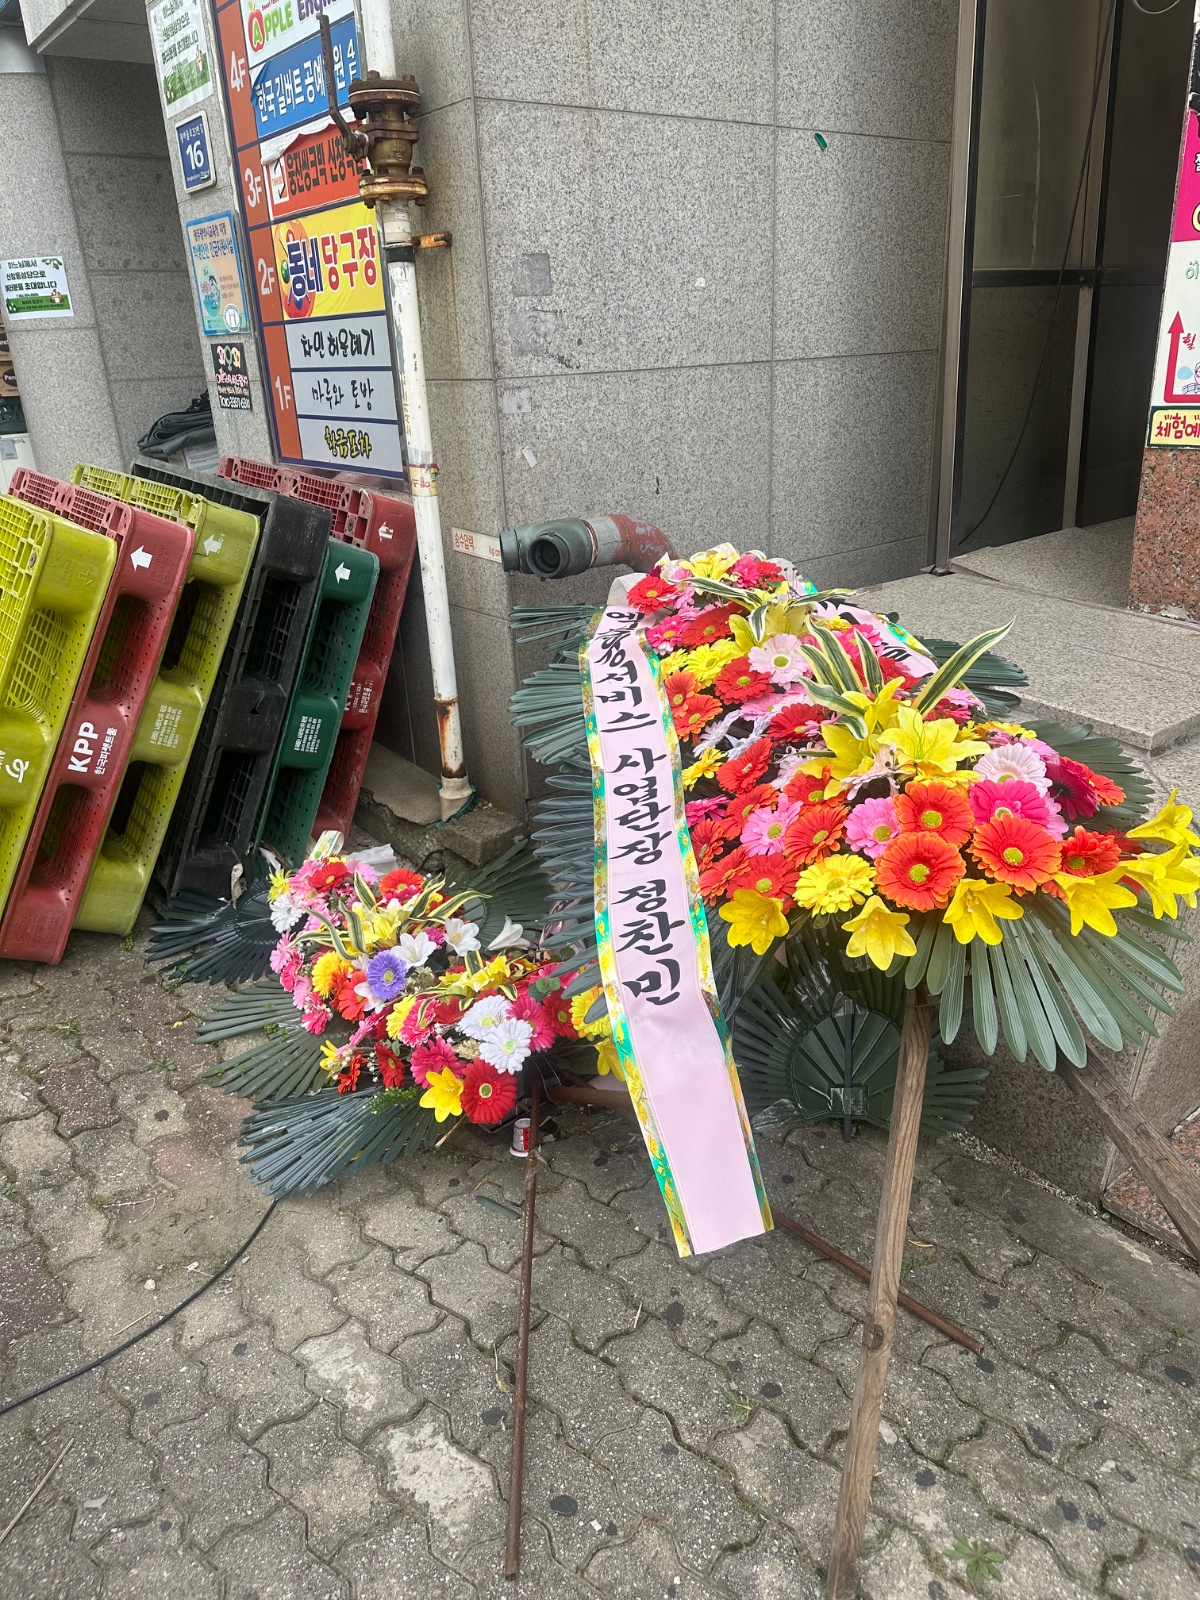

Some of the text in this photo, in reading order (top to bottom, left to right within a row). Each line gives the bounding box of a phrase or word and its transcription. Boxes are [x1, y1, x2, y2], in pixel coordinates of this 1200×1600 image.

[249, 1, 294, 50] APPLE
[231, 50, 246, 92] 4F
[255, 79, 277, 123] 한국
[275, 68, 305, 116] 길버트
[303, 43, 346, 103] 공예원
[186, 140, 204, 170] 16
[286, 135, 366, 196] 웅진씽크빅 신창
[244, 167, 262, 207] 3F
[24, 280, 57, 291] 초대합니다
[257, 257, 275, 296] 2F
[274, 375, 292, 411] 1F
[311, 378, 345, 411] 마루와
[325, 425, 372, 459] 황금포차
[455, 532, 475, 552] 송수압력
[67, 721, 99, 773] KPP
[94, 727, 118, 775] 한국파렛트풀
[605, 747, 673, 865] 사업단장
[611, 878, 686, 1006] 정찬민
